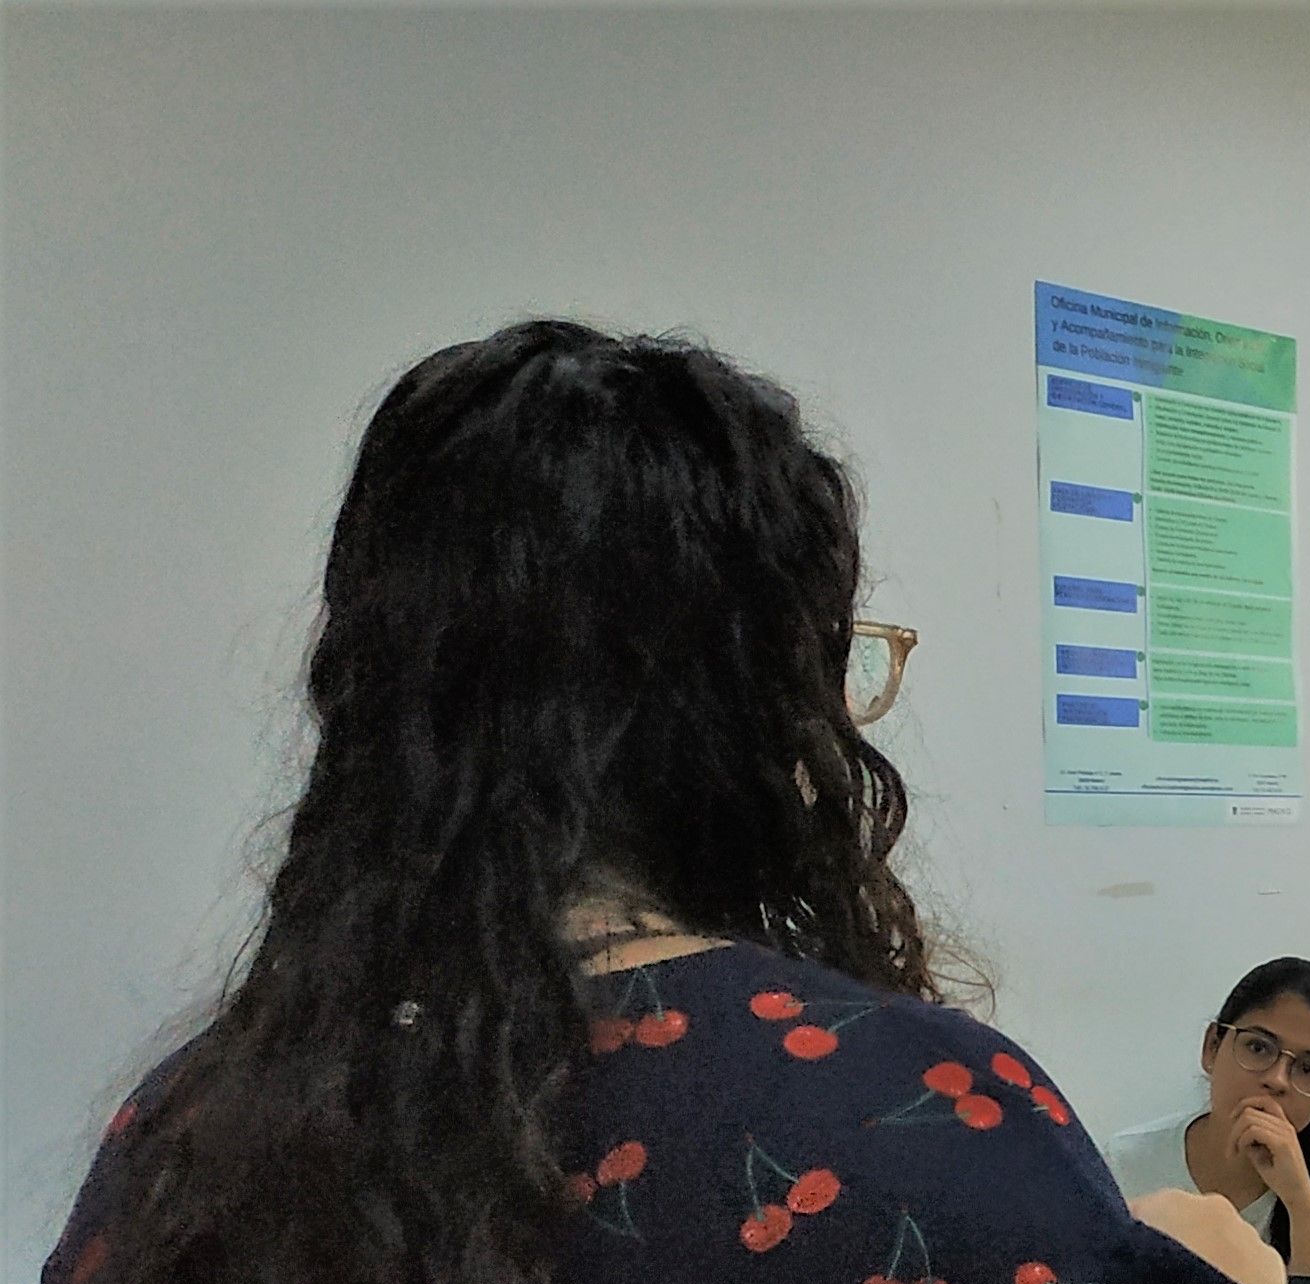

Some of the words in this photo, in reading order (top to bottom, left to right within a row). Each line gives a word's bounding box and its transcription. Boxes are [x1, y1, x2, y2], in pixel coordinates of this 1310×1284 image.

[1051, 295, 1088, 314] Oficina
[1090, 304, 1139, 325] Municipal
[1140, 315, 1153, 328] de
[1051, 320, 1059, 332] y
[1052, 340, 1067, 353] de
[1068, 343, 1079, 355] la
